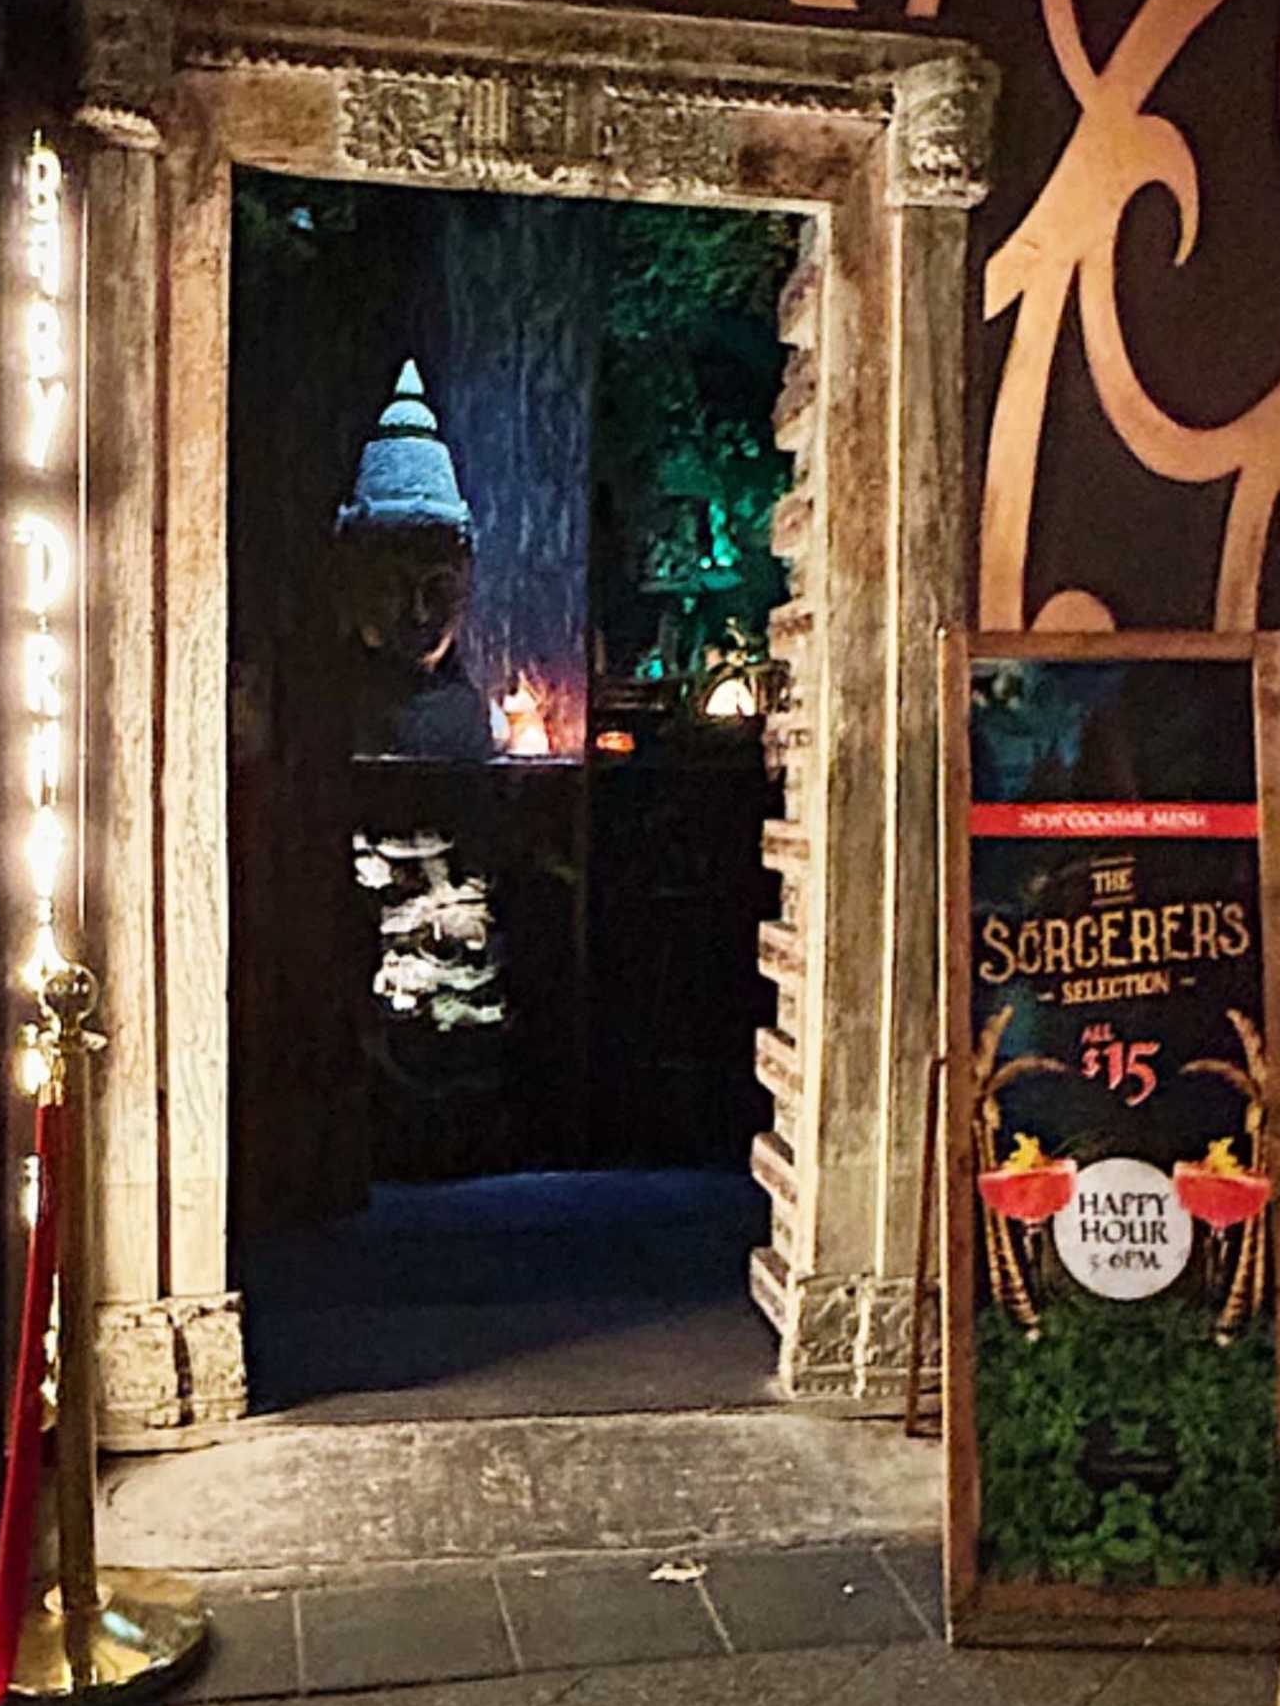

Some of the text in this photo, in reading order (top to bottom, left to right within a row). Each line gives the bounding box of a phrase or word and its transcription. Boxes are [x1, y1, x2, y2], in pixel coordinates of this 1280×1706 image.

[1065, 811, 1146, 828] COCKTAIL
[1151, 811, 1207, 827] MENU
[1091, 867, 1134, 894] THE
[1062, 972, 1170, 1004] SELECTION
[1080, 1022, 1114, 1044] ALL
[1080, 1036, 1161, 1107] $15
[1078, 1192, 1169, 1218] HAPPY
[1080, 1217, 1168, 1246] HOUR
